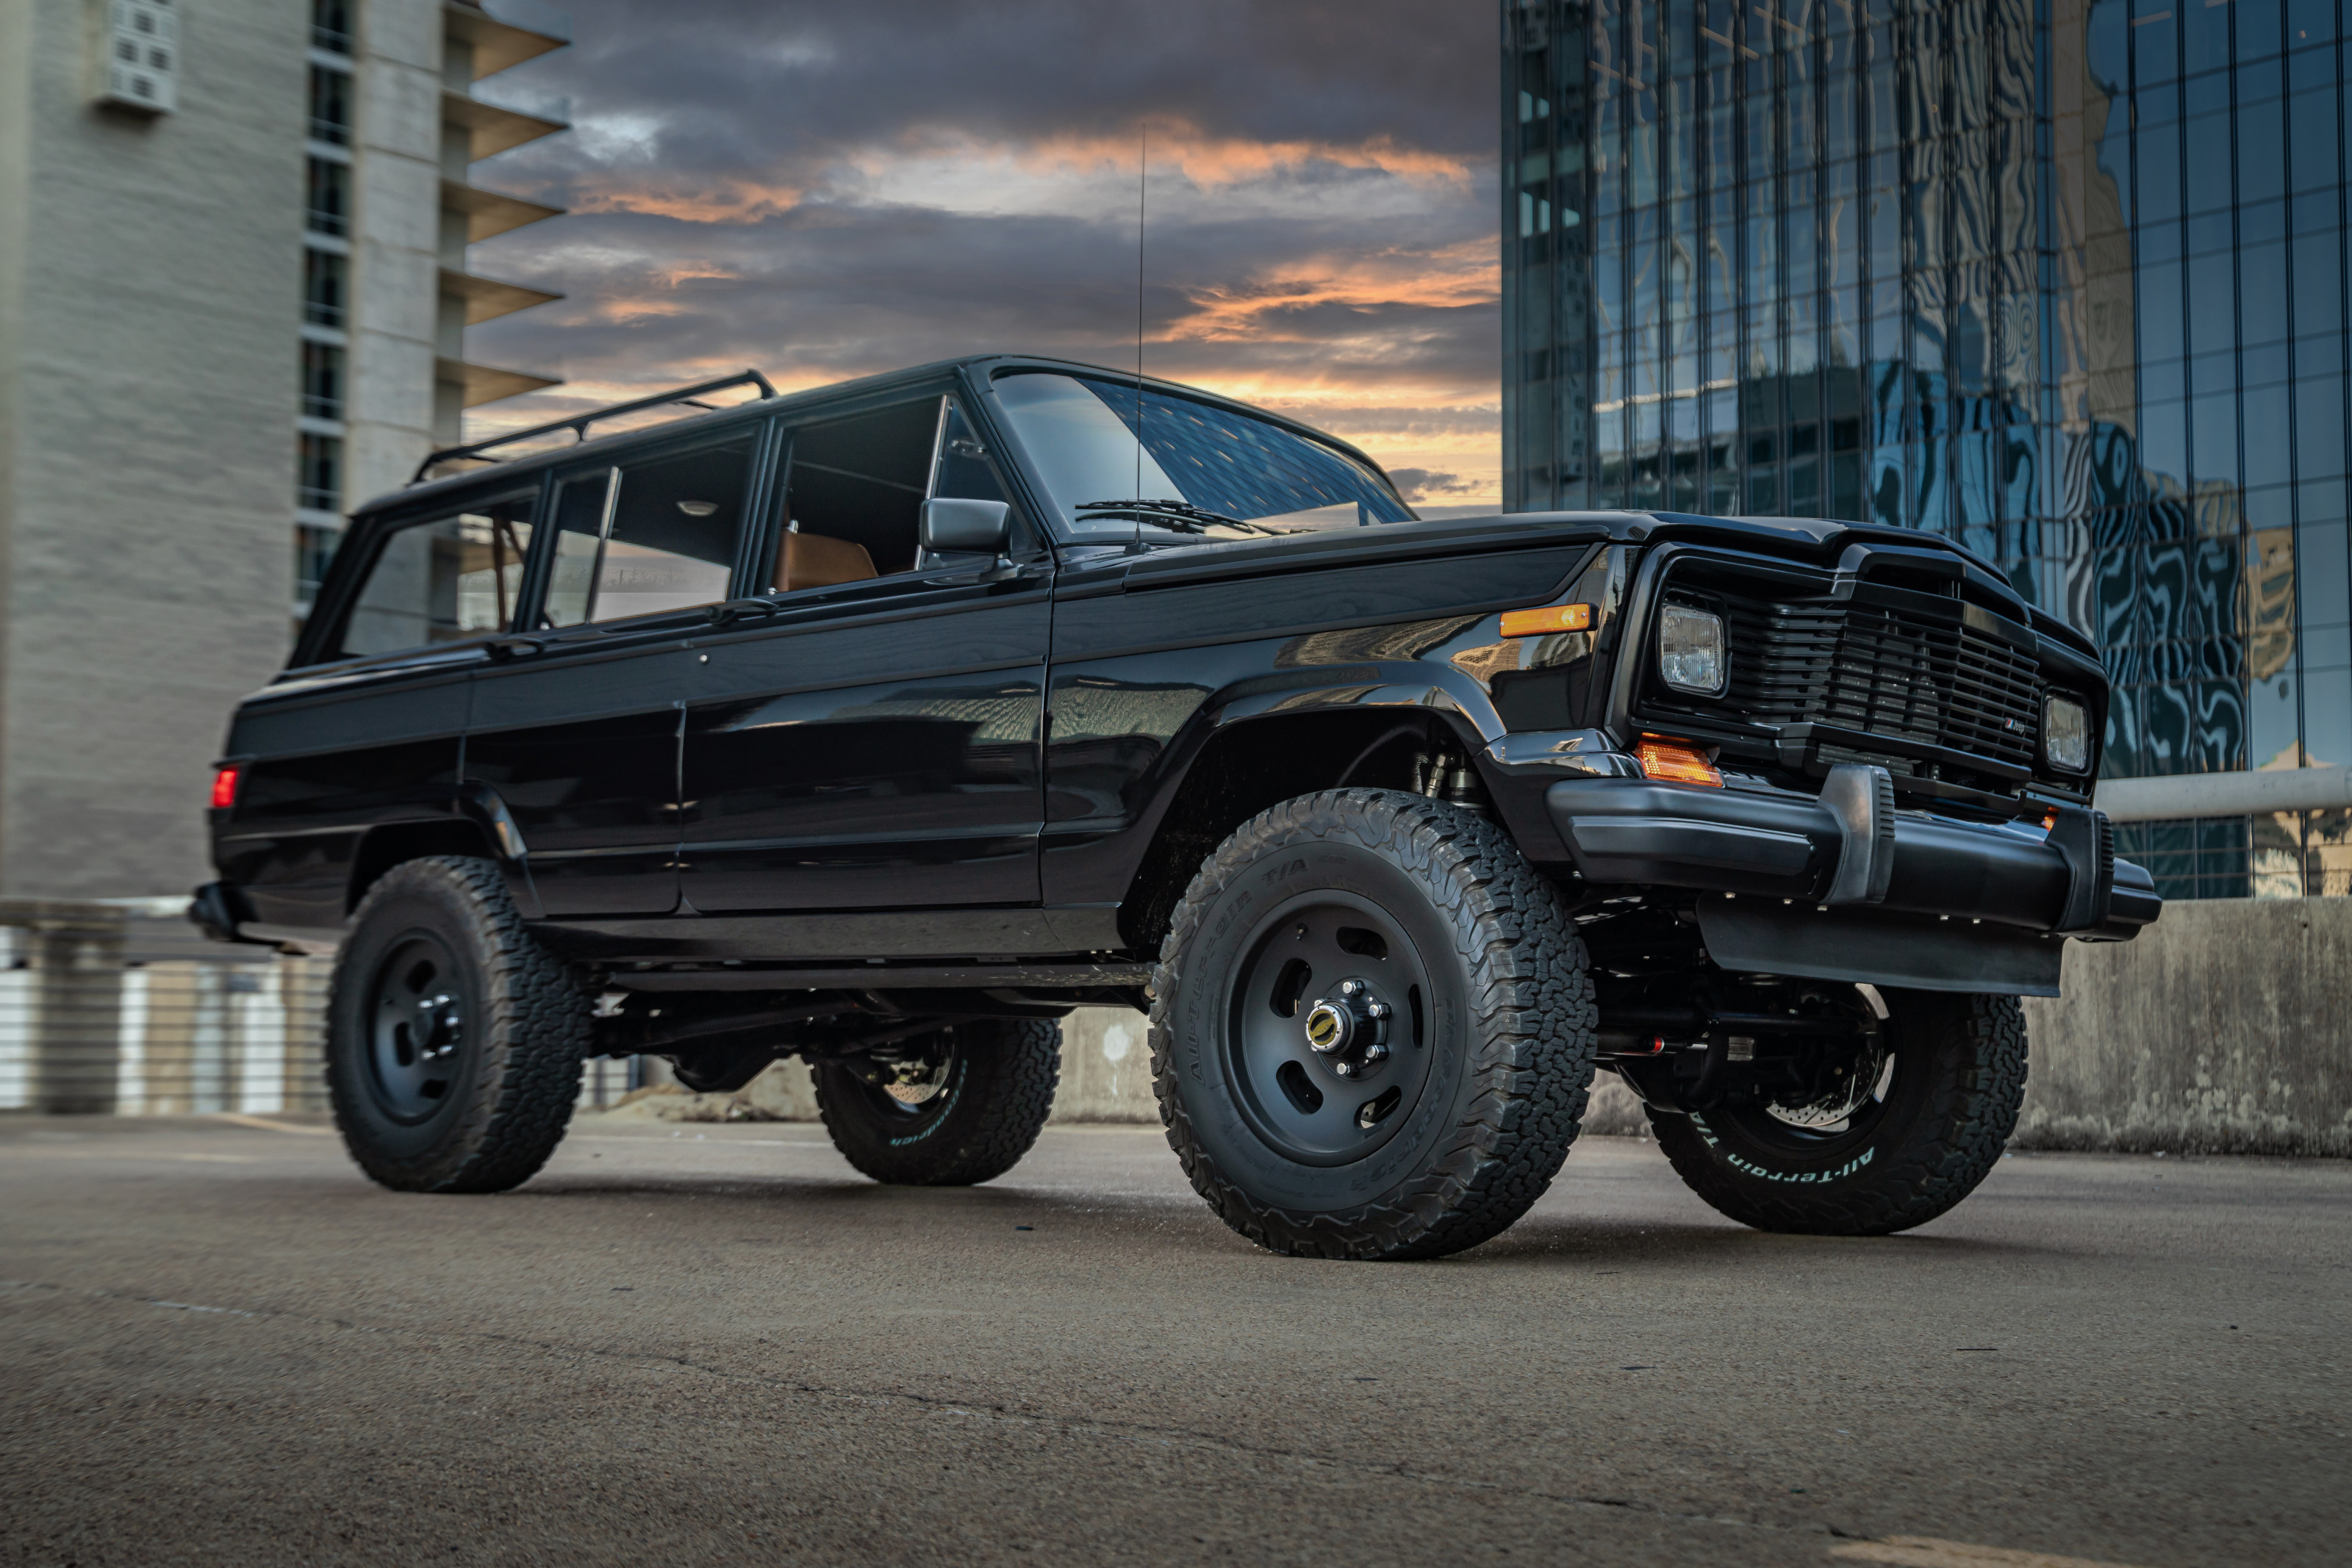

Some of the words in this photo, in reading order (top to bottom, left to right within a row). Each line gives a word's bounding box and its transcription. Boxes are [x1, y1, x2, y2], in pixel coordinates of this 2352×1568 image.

[2013, 719, 2025, 735] Jeep
[1186, 889, 1252, 1085] All-Terrain
[1261, 857, 1309, 887] T/A
[1349, 997, 1455, 1191] BFGoodrich
[1688, 1111, 1720, 1148] T/A
[1727, 1146, 1875, 1184] All-Terrain
